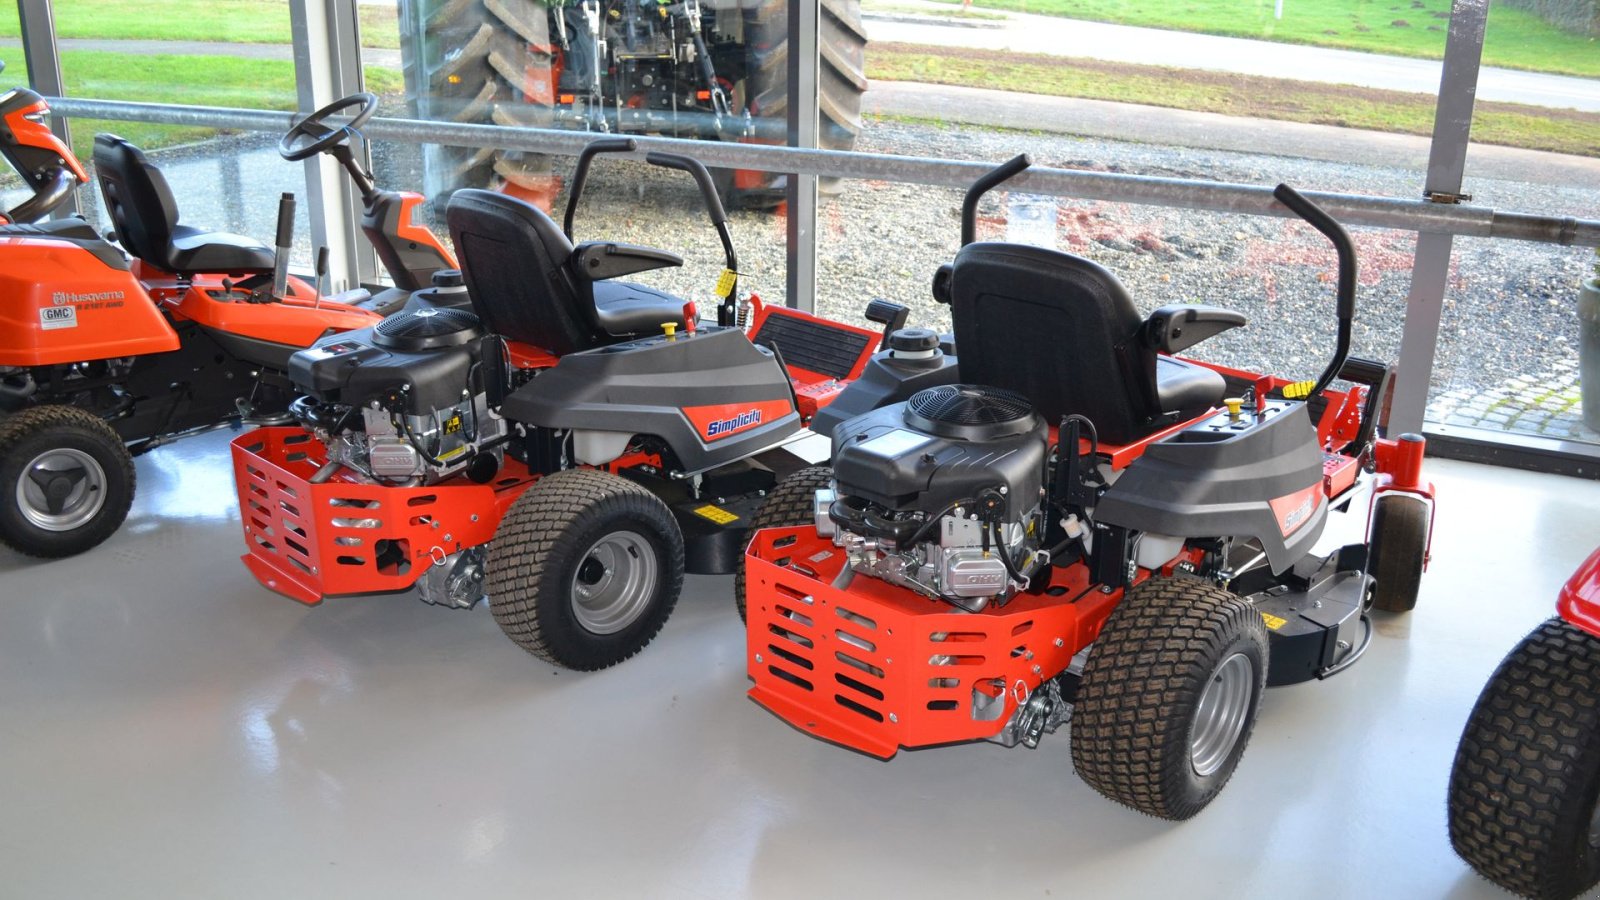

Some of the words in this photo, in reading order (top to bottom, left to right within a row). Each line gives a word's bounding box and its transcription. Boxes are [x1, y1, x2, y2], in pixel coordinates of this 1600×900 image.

[65, 291, 125, 303] Husqvarna
[46, 307, 70, 320] GMC
[707, 408, 762, 437] Simplicity
